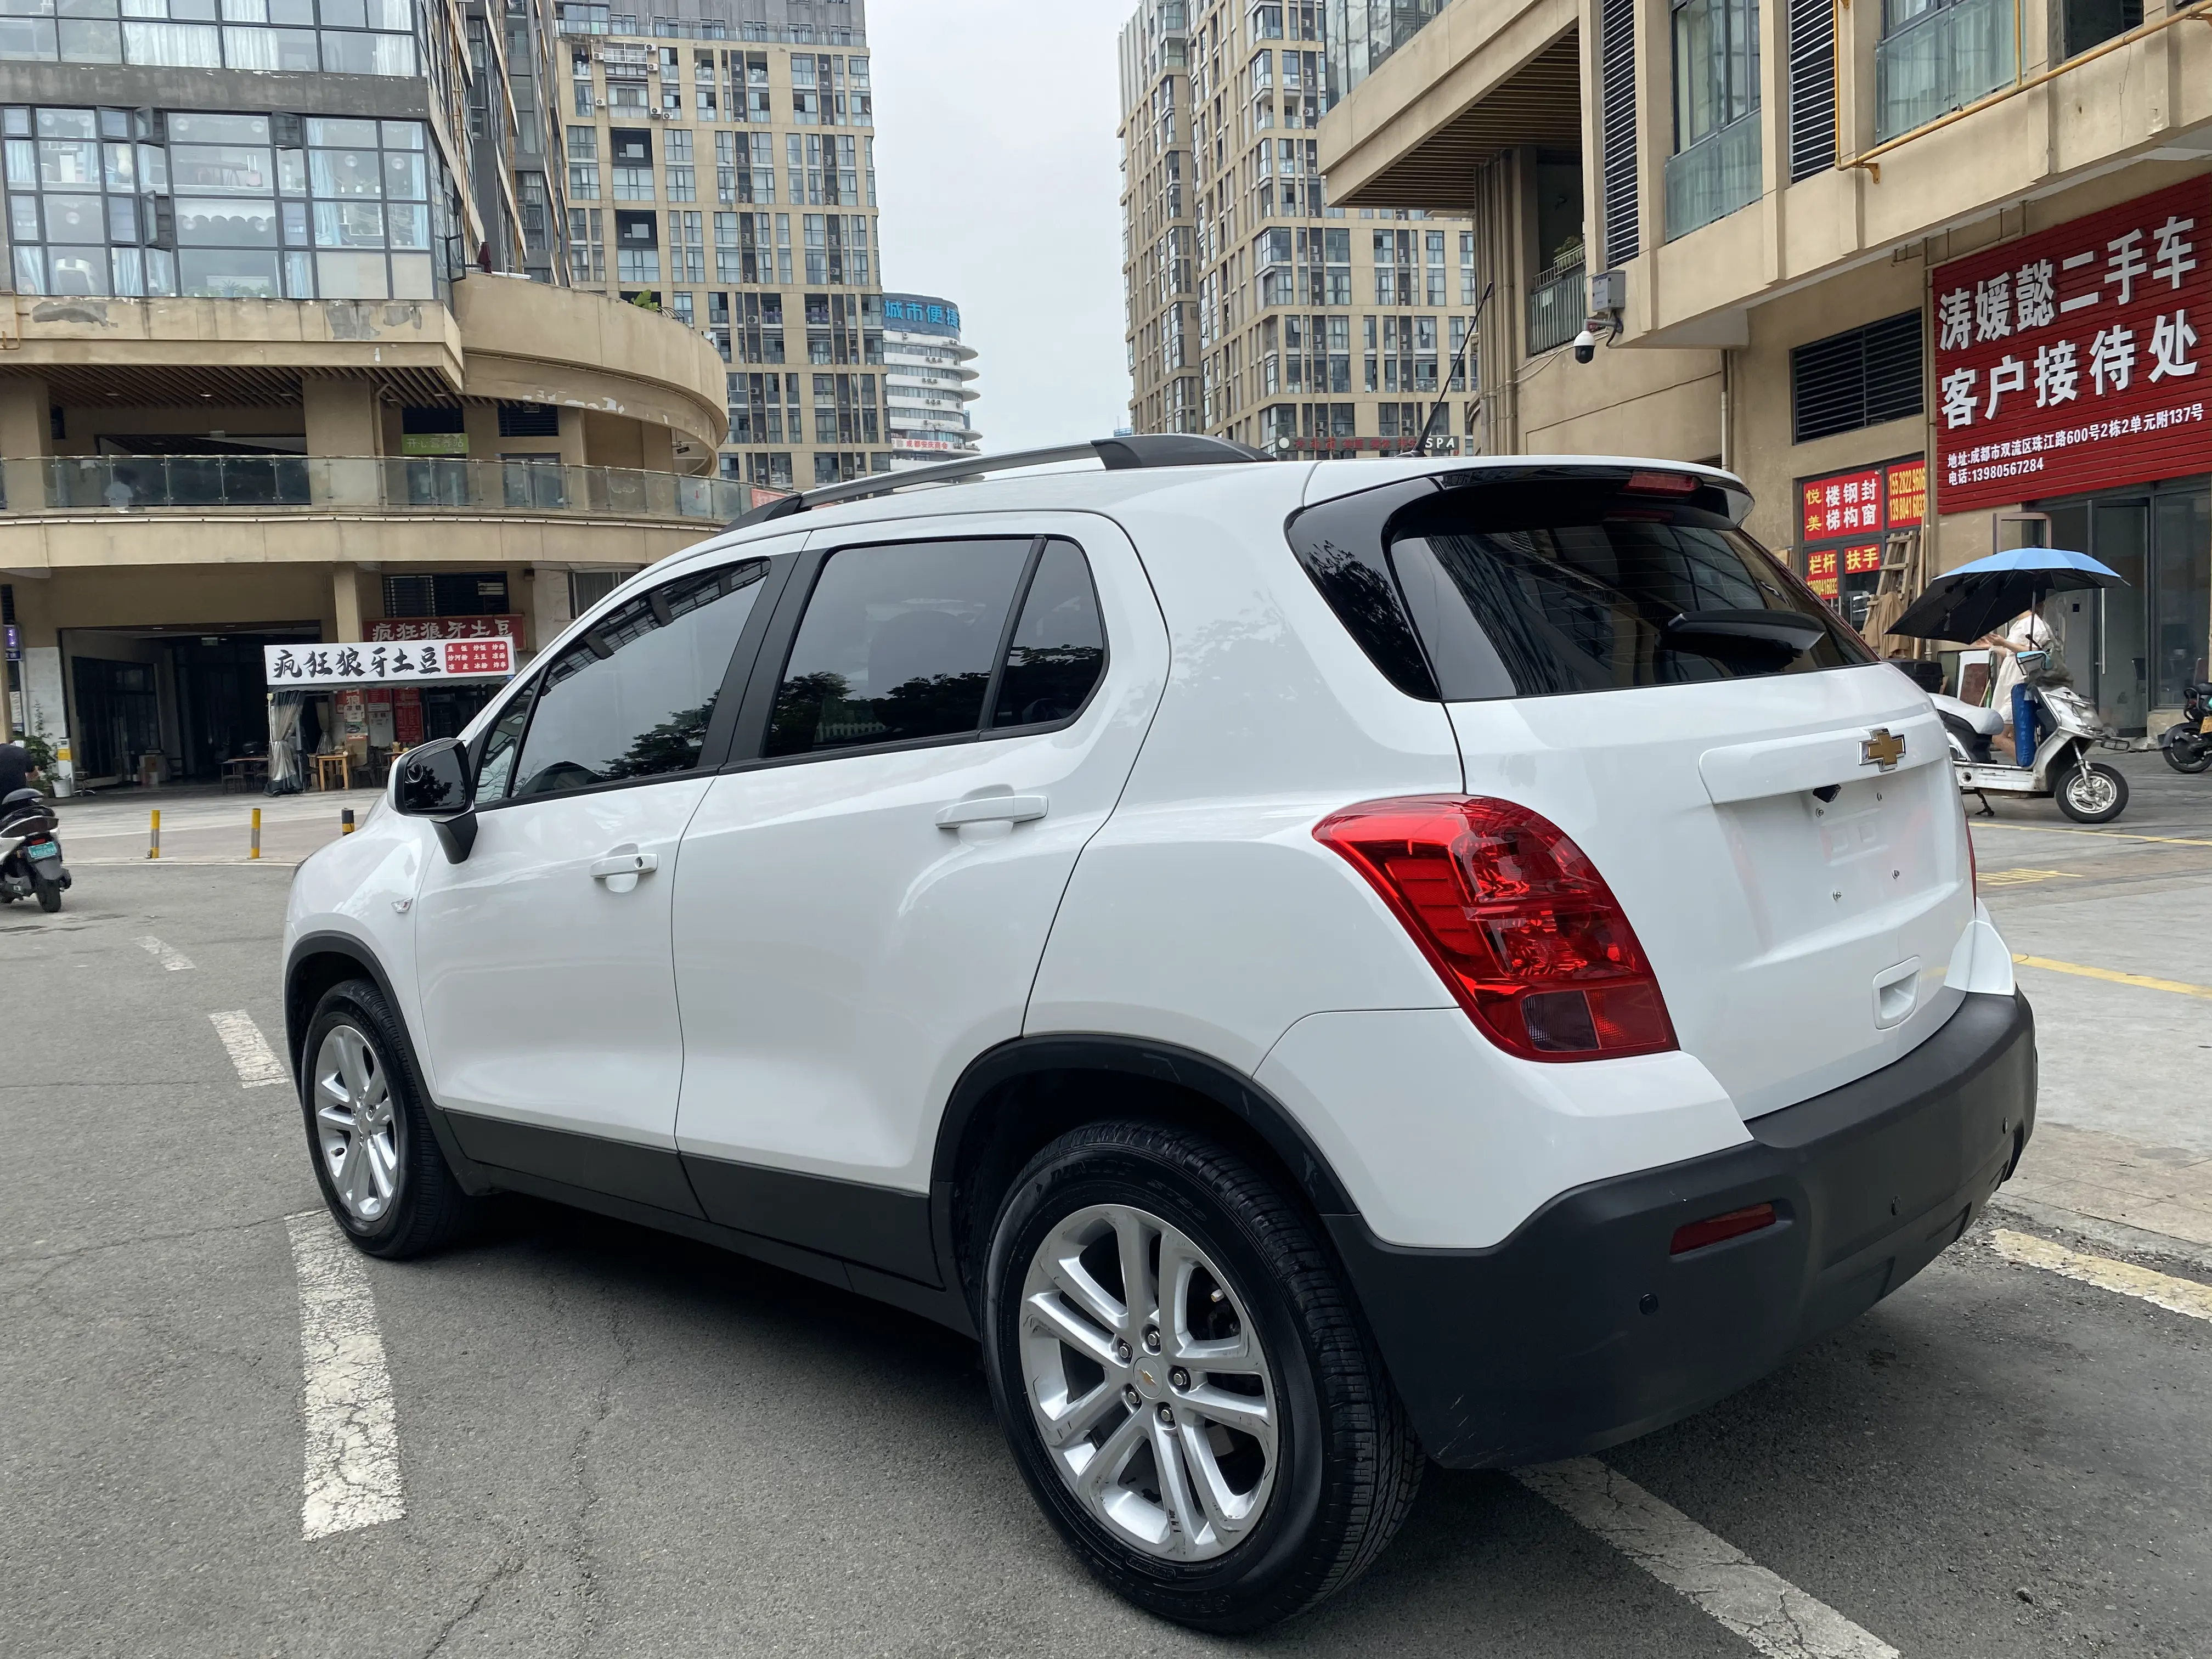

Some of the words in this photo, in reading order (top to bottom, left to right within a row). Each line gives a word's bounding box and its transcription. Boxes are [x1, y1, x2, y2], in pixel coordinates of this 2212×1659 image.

[1939, 216, 2197, 351] 涛媛懿二手车
[1941, 309, 2199, 430] 客户接待处
[1425, 437, 1455, 449] SPA
[1948, 457, 2044, 486] 电话:13980567284
[1806, 488, 1822, 532] 悦美
[1809, 553, 1836, 575] 栏杆
[1846, 547, 1878, 571] 扶手
[372, 619, 513, 642] 疯狂狼牙土豆
[272, 646, 441, 678] 疯狂狼牙土豆
